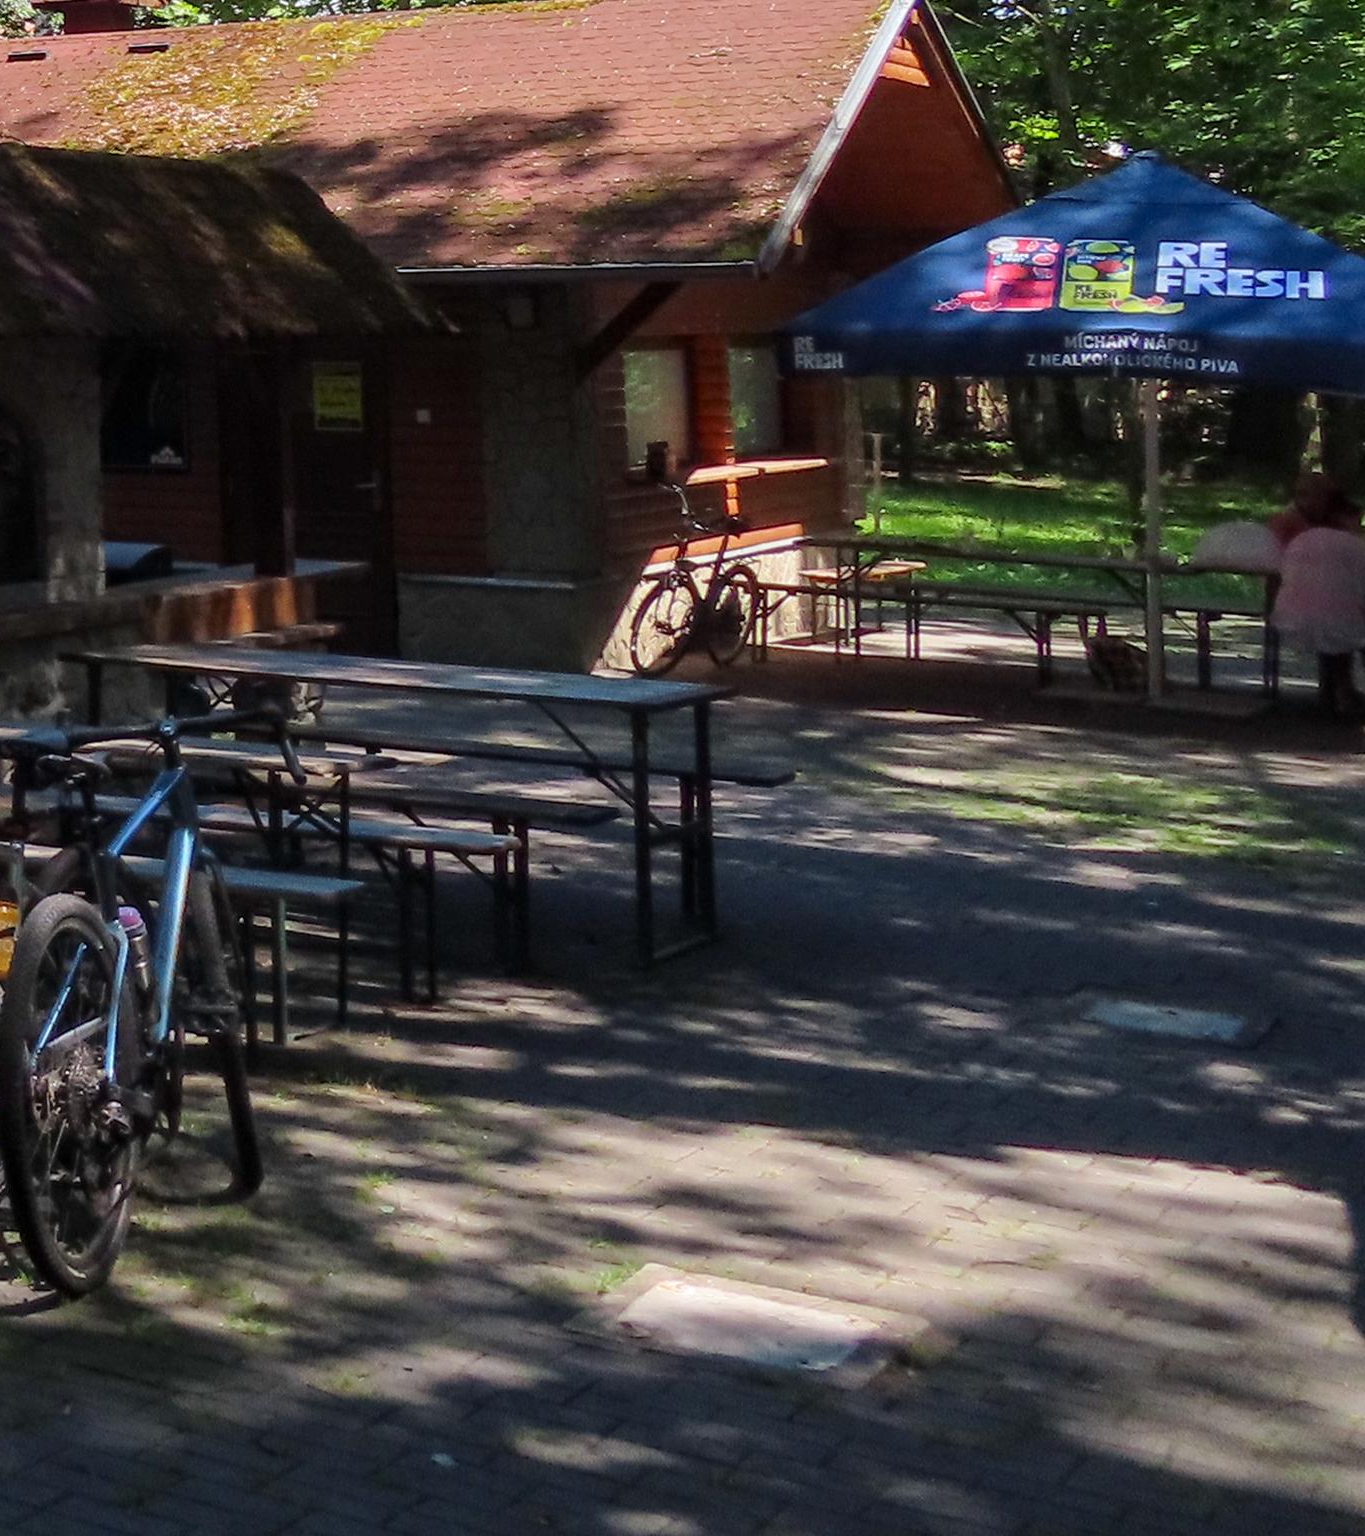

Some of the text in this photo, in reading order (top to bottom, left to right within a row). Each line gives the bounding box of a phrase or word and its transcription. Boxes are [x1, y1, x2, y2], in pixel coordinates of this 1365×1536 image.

[1157, 241, 1228, 268] RE
[1155, 267, 1325, 299] FRESH
[794, 336, 814, 352] RE
[1064, 332, 1199, 352] MÍCHANÝ NÁPOJ
[794, 352, 844, 369] FRESH
[1026, 353, 1036, 366] Z
[1200, 357, 1239, 373] PIVA
